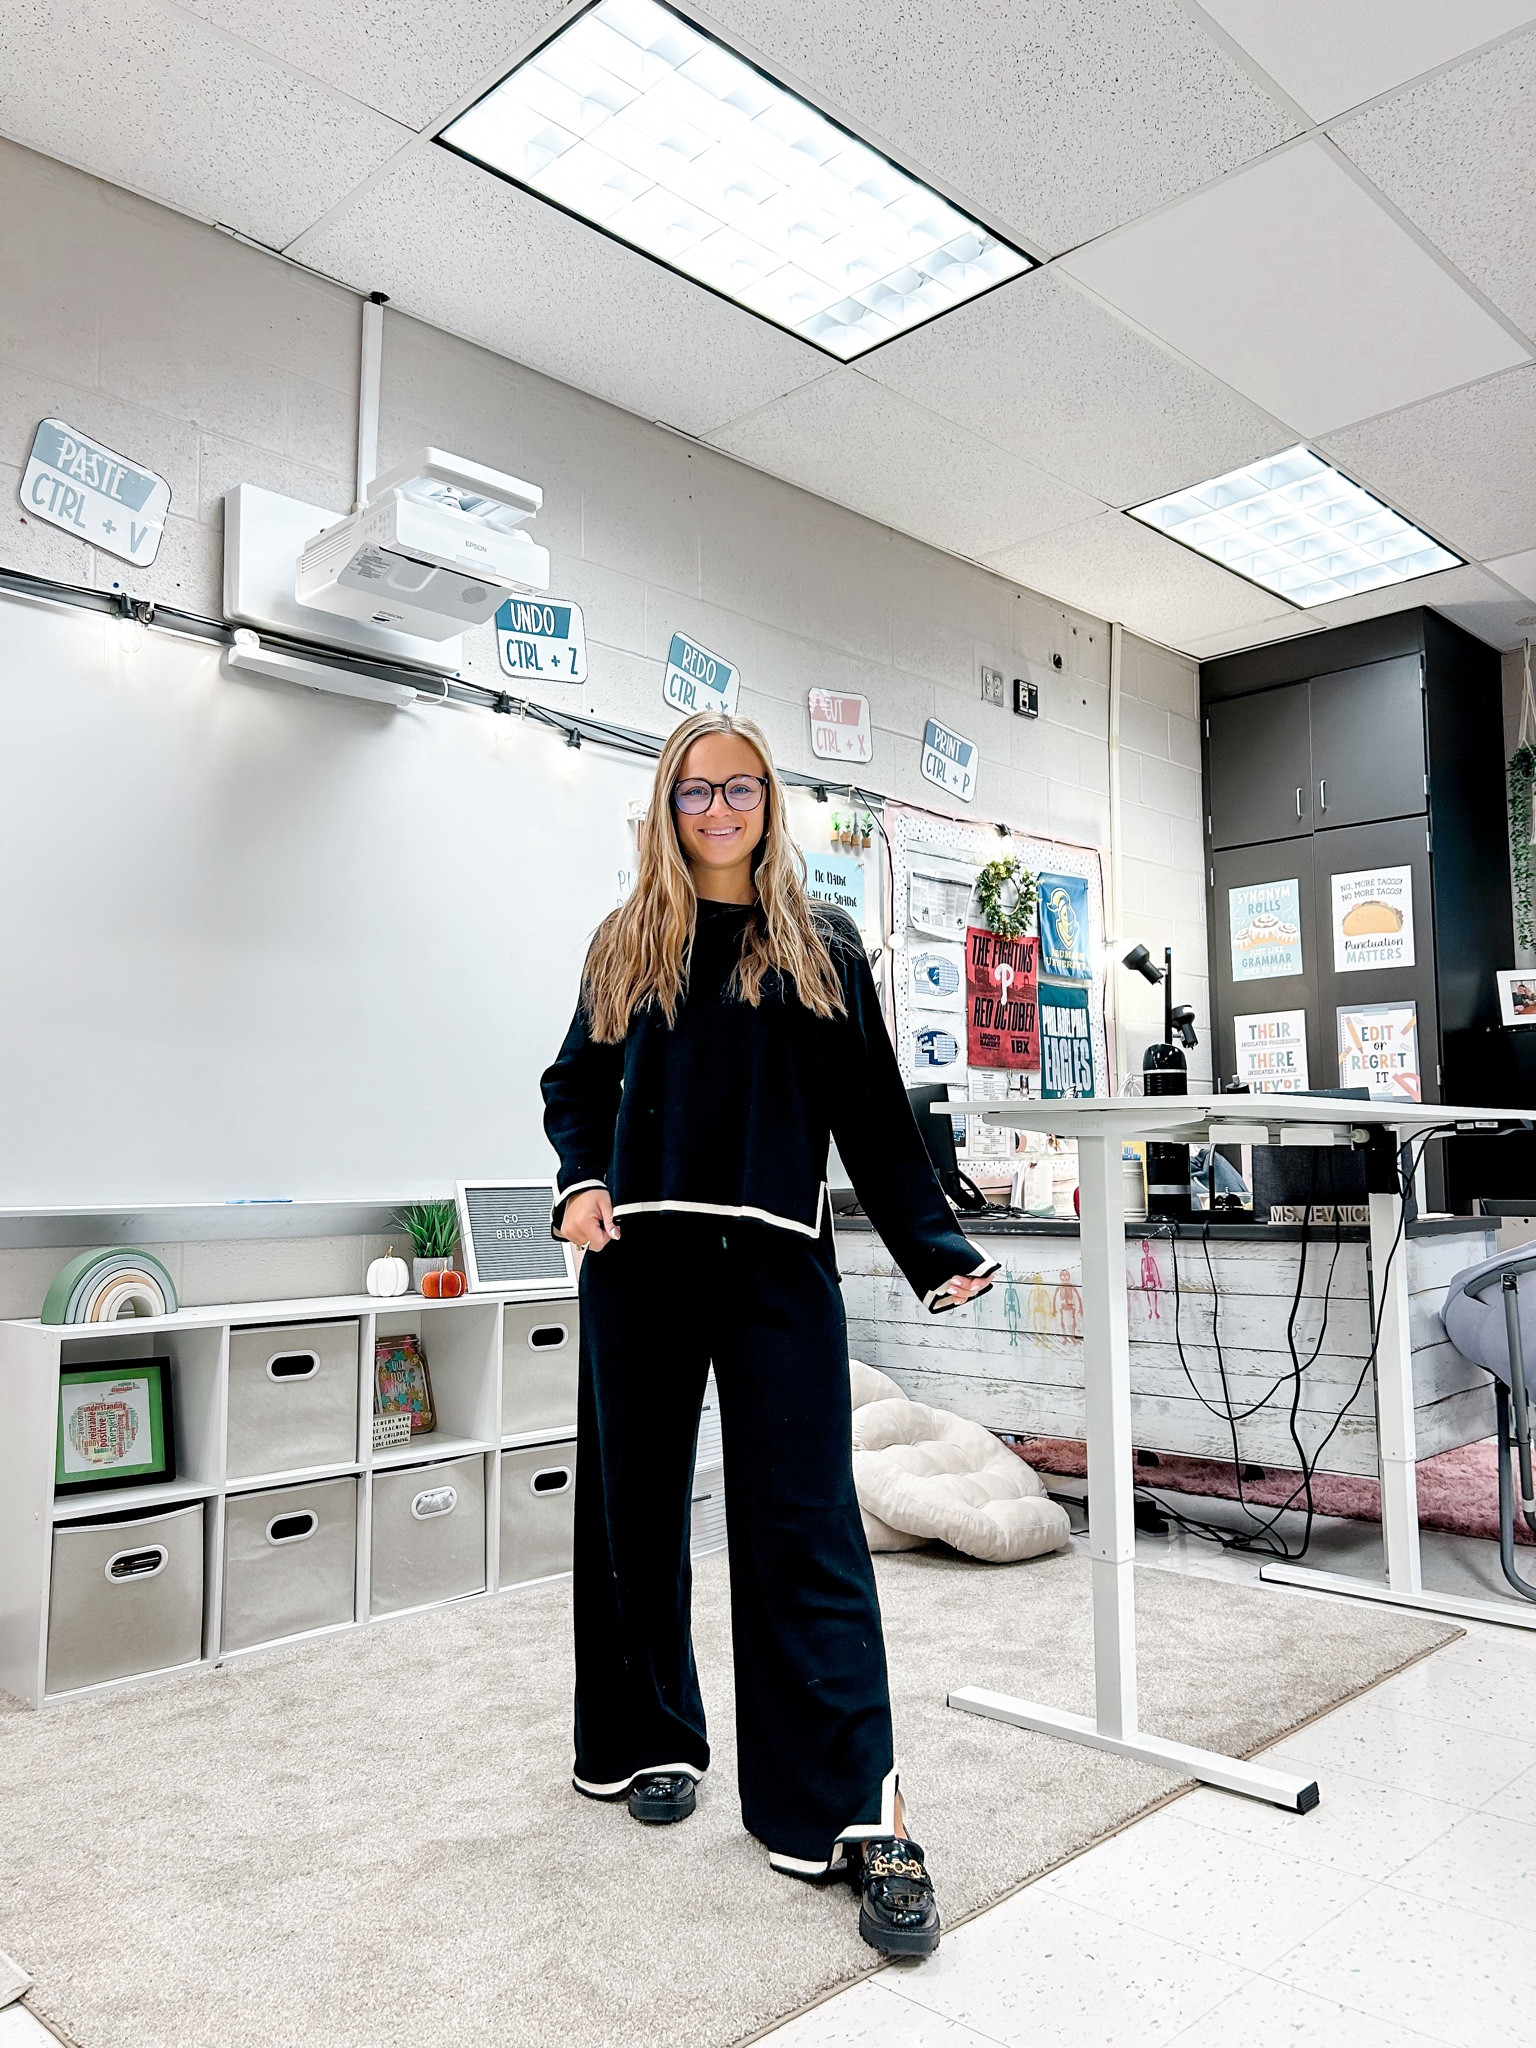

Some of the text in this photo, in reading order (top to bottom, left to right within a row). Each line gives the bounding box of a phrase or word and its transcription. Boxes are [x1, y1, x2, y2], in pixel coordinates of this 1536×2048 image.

[57, 436, 129, 500] PASTE
[32, 473, 148, 554] CTRL + V
[465, 540, 488, 553] EPSON
[510, 602, 555, 636] UNDO
[506, 639, 578, 675] CTRL + Z
[681, 644, 717, 685] REDO
[670, 673, 697, 711] CTRL
[823, 697, 844, 723] CUT
[816, 727, 866, 756] CTRL + X
[933, 727, 961, 761] PRINT
[926, 752, 970, 793] CTRL + P
[1355, 879, 1375, 888] MORE
[1377, 877, 1403, 885] TACOS!
[1237, 885, 1290, 904] SYNONYM
[1341, 887, 1402, 901] NO MORE TACOS!
[1248, 900, 1280, 915] ROLLS
[1268, 945, 1284, 954] LIKE
[1344, 938, 1403, 950] Punctuation
[972, 935, 1034, 974] THE FIGHTINS
[1242, 953, 1291, 968] GRAMMAR
[1346, 948, 1402, 964] MATTERS
[1243, 963, 1292, 975] USED TO MAKE
[974, 996, 1035, 1033] RED OCTOBER
[1042, 1004, 1088, 1038] PHILADELPHIA
[1249, 1022, 1290, 1040] THEIR
[1361, 1025, 1393, 1041] EDIT
[1011, 1040, 1030, 1054] IBX
[1373, 1042, 1387, 1051] or
[1043, 1036, 1092, 1091] EAGLES
[1249, 1051, 1294, 1069] THERE
[1351, 1053, 1406, 1070] REGRET
[1375, 1071, 1389, 1083] IT
[503, 1214, 519, 1224] GO
[1270, 1206, 1299, 1222] MS.
[496, 1226, 534, 1239] BIRDS!
[83, 1402, 126, 1412] understanding
[88, 1411, 97, 1440] relatable
[97, 1418, 110, 1447] positive
[107, 1409, 117, 1447] energetic
